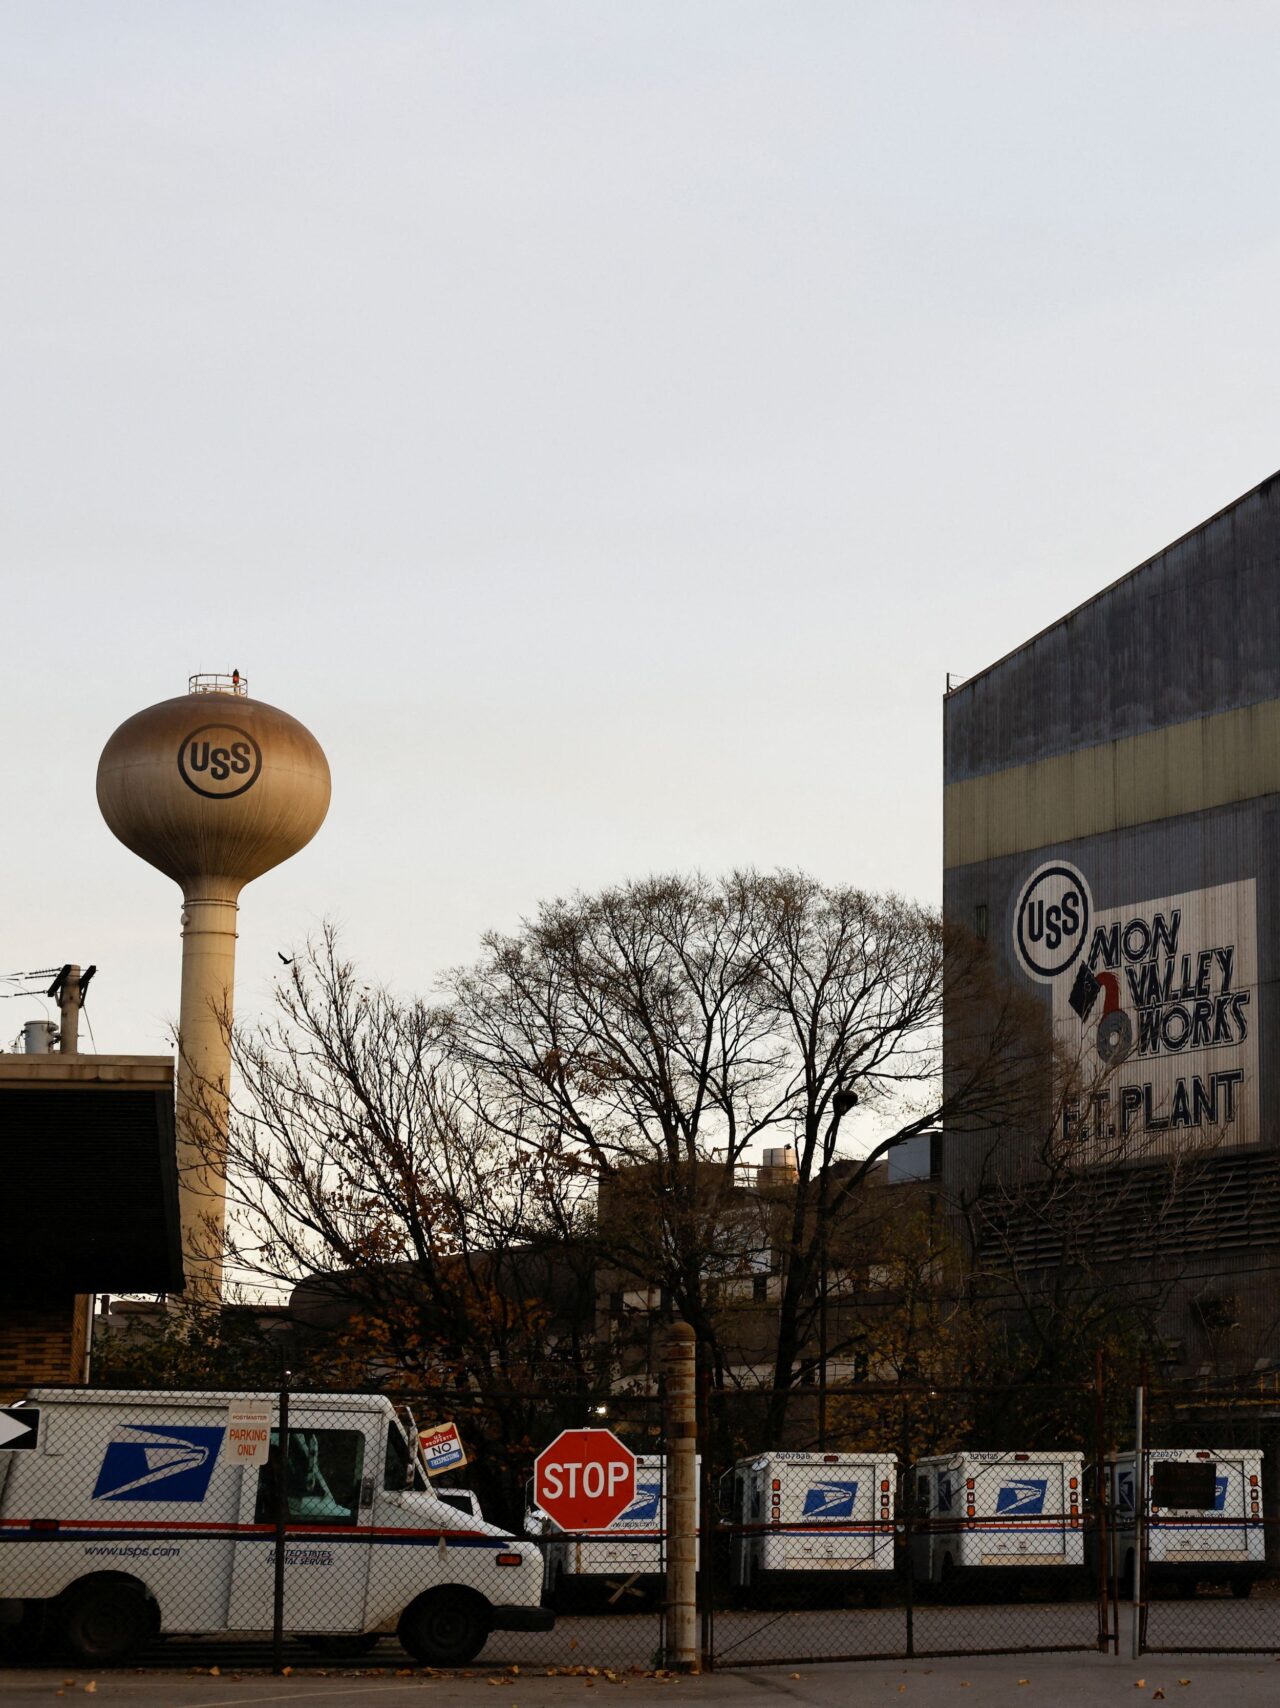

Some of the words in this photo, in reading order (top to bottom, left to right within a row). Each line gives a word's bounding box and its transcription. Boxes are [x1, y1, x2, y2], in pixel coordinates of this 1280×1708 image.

[190, 742, 250, 781] USS
[1028, 891, 1080, 950] USS
[1087, 909, 1181, 971] MON
[1125, 945, 1235, 1009] VALLEY
[1138, 990, 1251, 1056] WORKS
[1119, 1069, 1245, 1137] PLANT
[229, 1429, 268, 1441] PARKING
[237, 1443, 257, 1456] ONLY
[425, 1434, 453, 1447] PROPERTY
[432, 1443, 451, 1456] NO
[542, 1461, 630, 1499] STOP
[84, 1546, 180, 1558] www.usps.com
[303, 1550, 333, 1558] STATES
